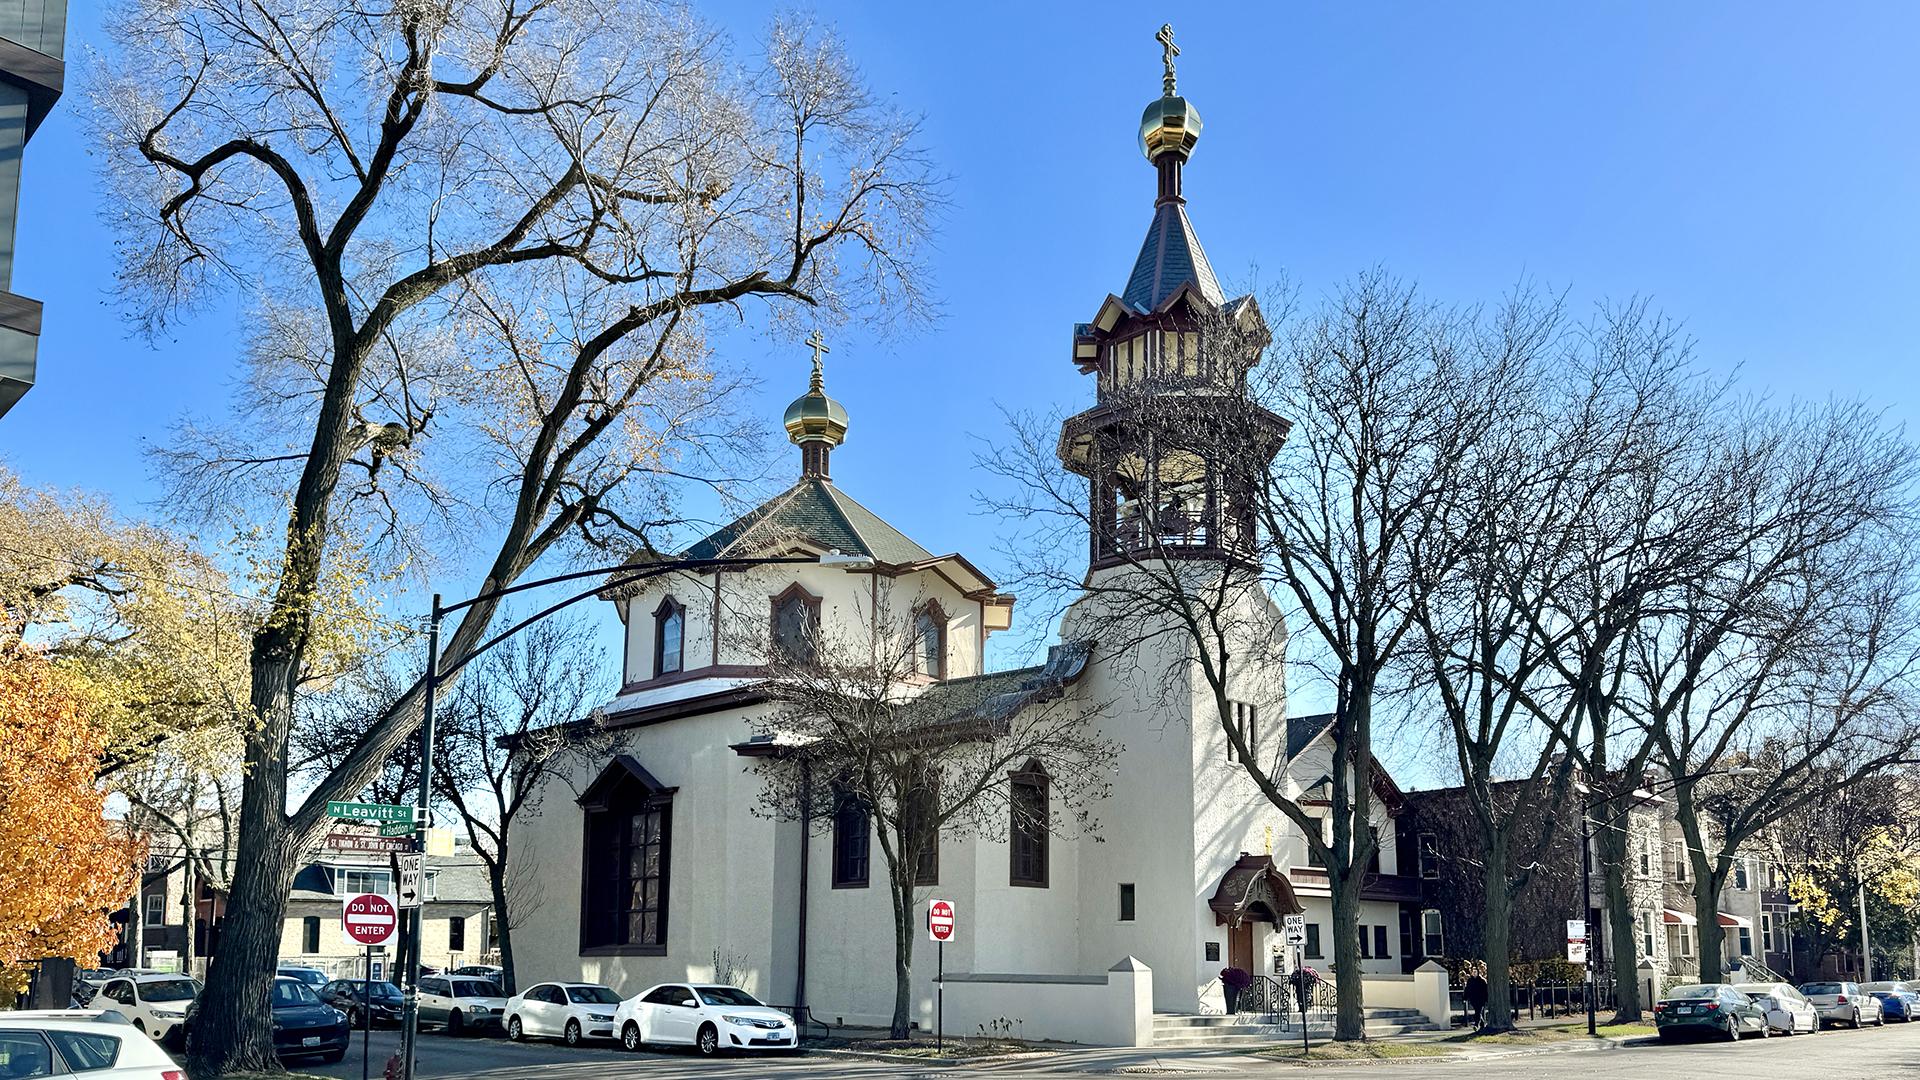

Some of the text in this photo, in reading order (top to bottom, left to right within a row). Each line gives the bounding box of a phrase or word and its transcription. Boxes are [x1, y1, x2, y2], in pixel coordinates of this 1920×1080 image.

[333, 805, 407, 818] N Leavitt St
[386, 824, 409, 836] Haddon
[403, 858, 420, 872] ONE
[402, 873, 419, 886] WAY
[351, 903, 389, 913] DO NOT
[941, 908, 951, 916] NOT
[1287, 917, 1302, 925] ONE
[355, 926, 385, 935] ENTER
[1288, 925, 1303, 933] WAY
